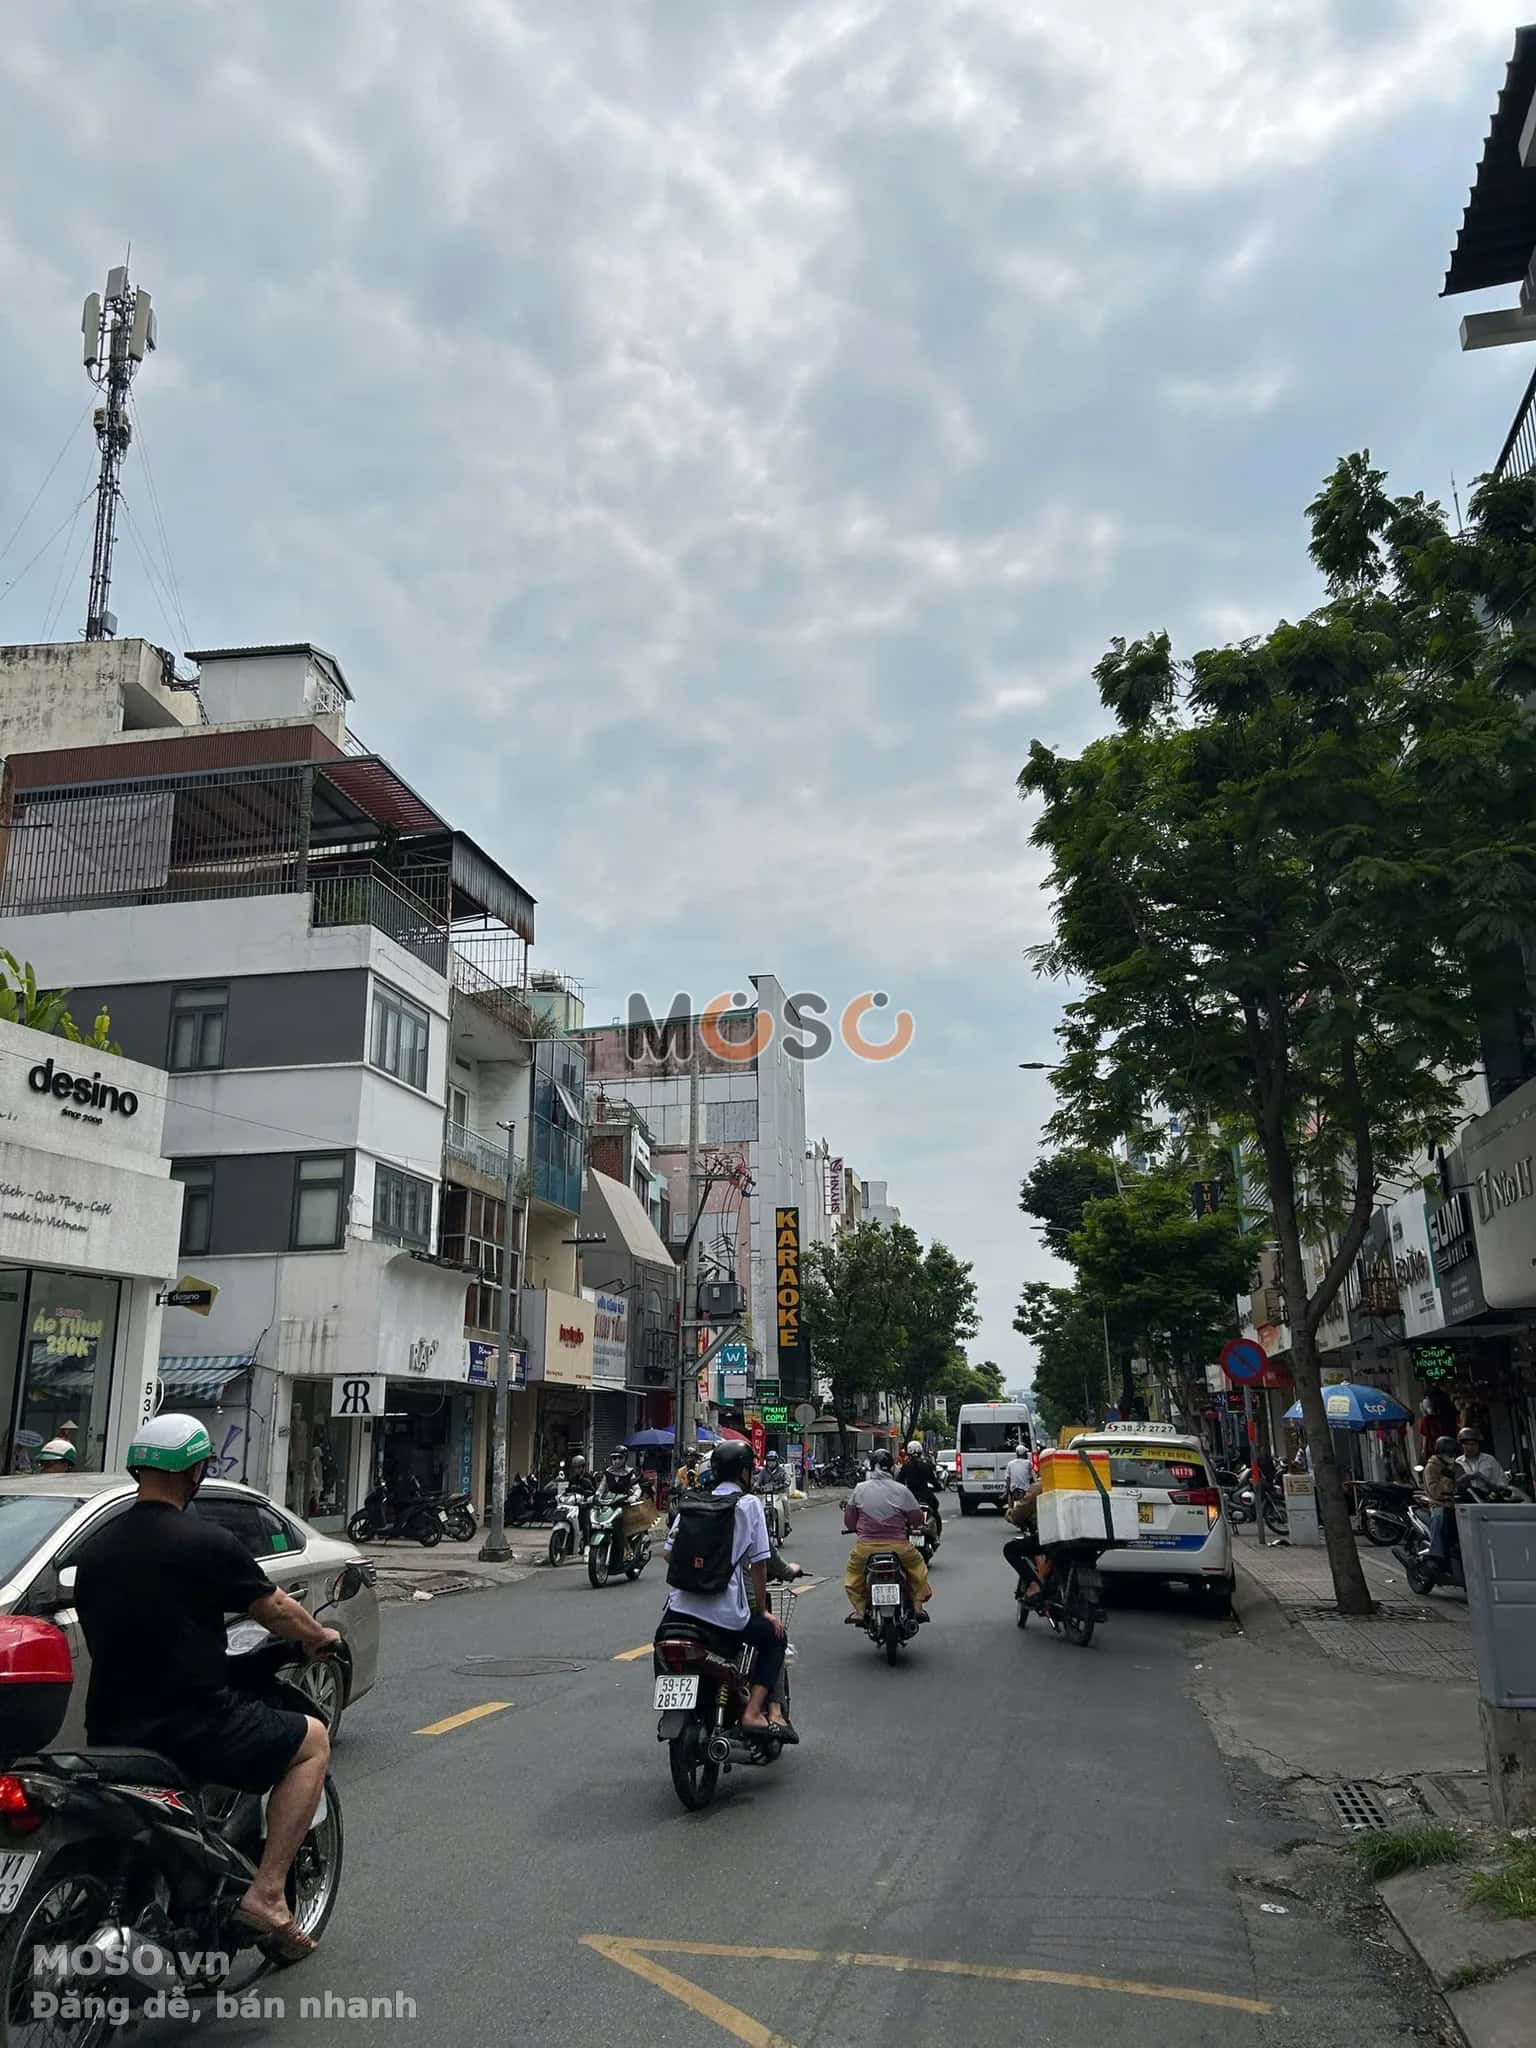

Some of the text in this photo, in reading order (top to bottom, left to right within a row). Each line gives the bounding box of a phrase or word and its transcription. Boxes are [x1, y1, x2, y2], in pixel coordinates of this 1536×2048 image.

[29, 1058, 138, 1116] desino
[776, 1210, 800, 1347] KARAOKE
[726, 1352, 740, 1362] W
[662, 1678, 692, 1692] 59-F2
